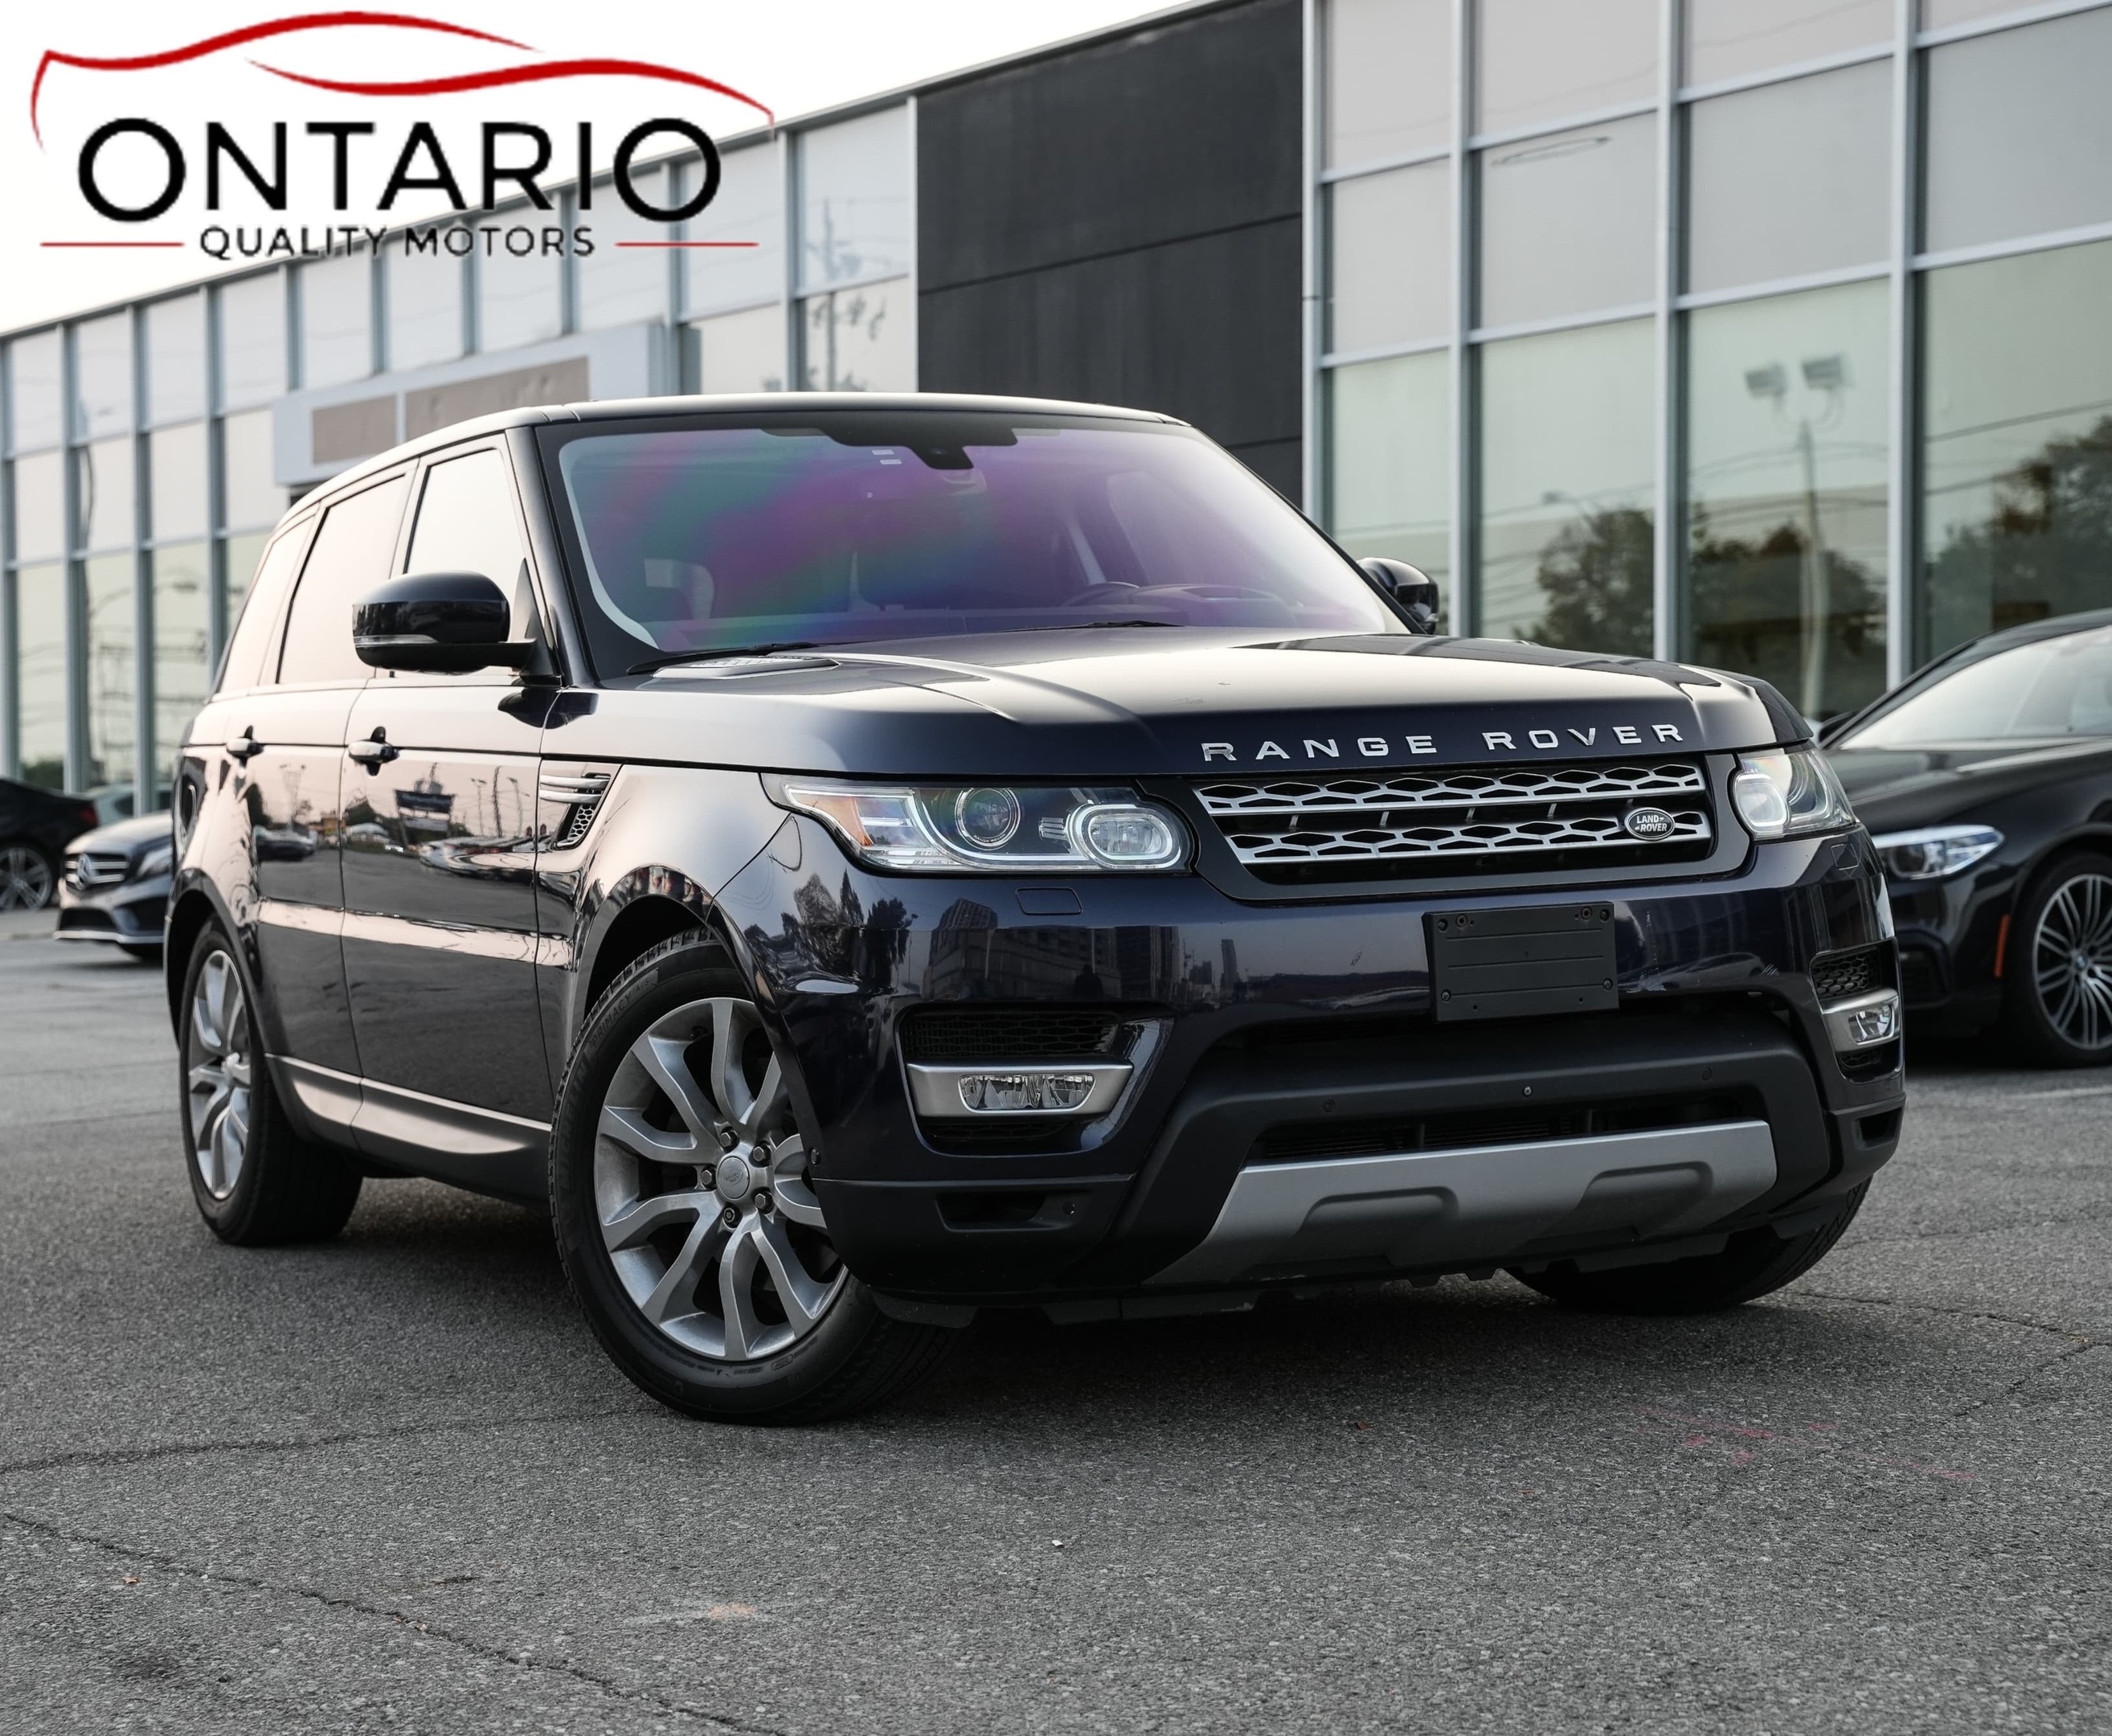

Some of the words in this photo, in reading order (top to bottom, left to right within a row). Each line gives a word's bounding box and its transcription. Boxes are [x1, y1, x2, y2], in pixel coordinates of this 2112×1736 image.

[1201, 735, 1438, 762] RANGE
[1480, 724, 1684, 751] ROVER
[1636, 815, 1660, 824] LAND
[1640, 823, 1668, 833] ROVER
[591, 992, 632, 1048] PRIMACY
